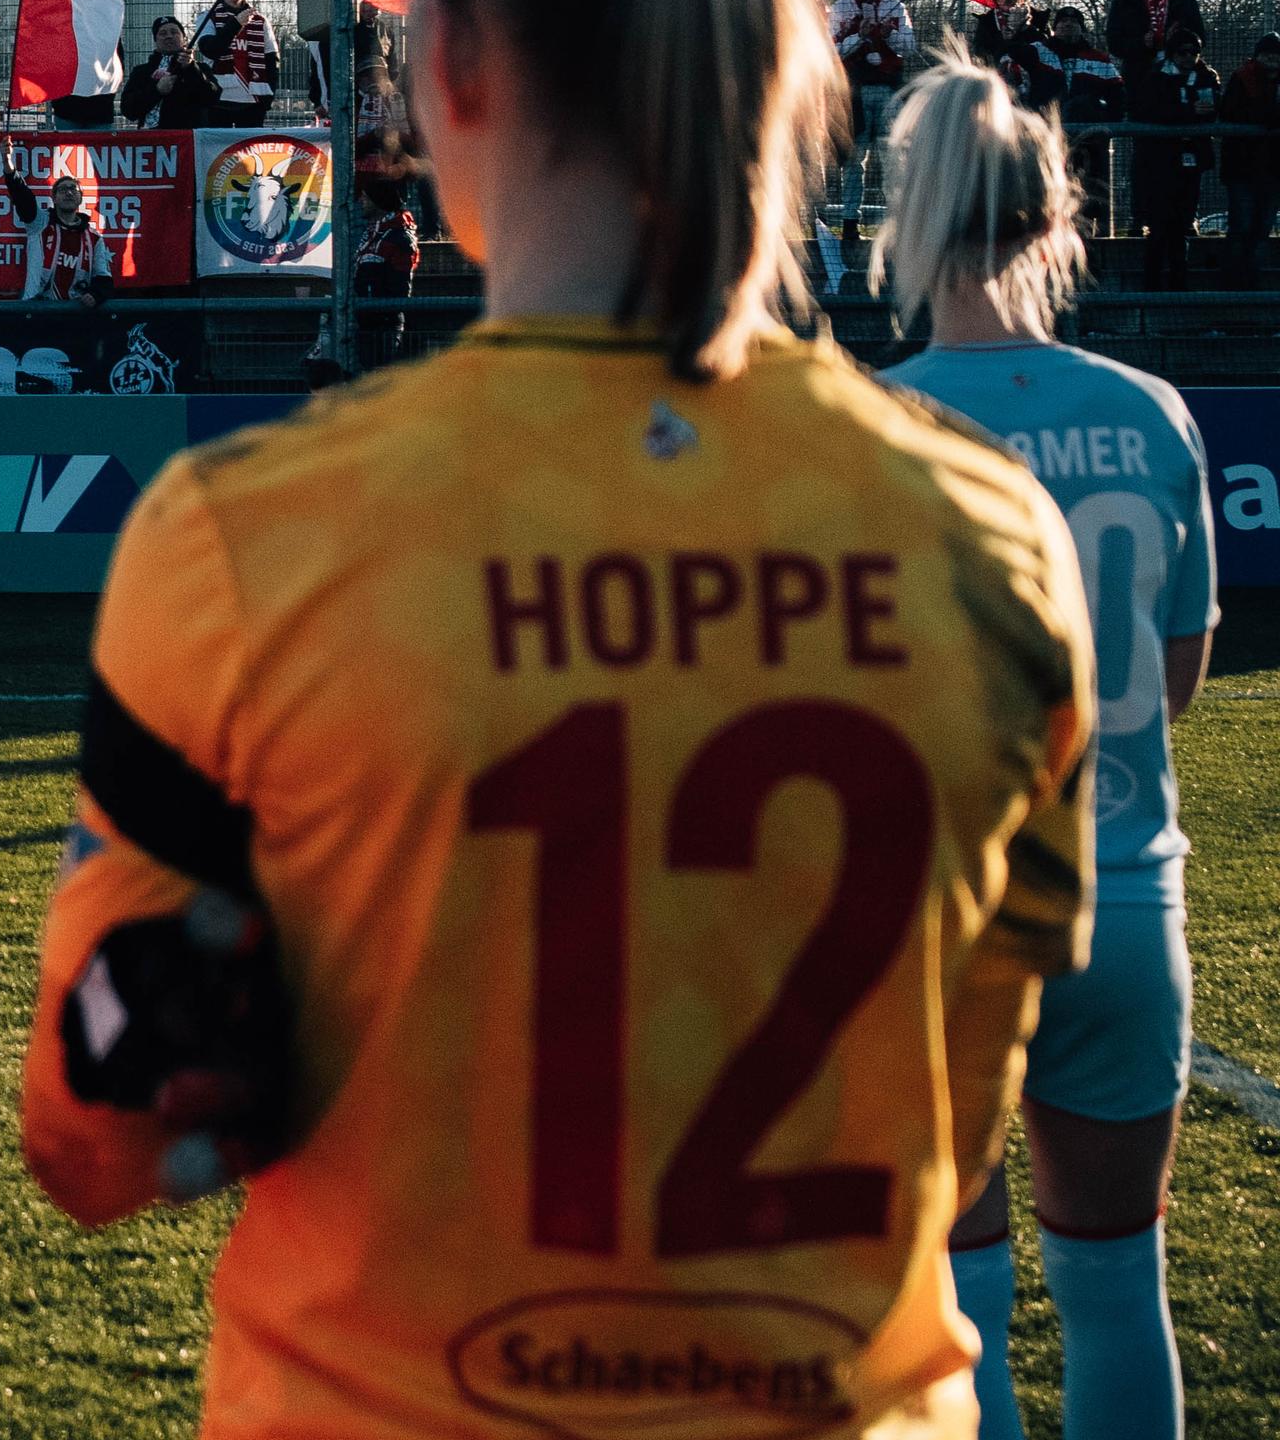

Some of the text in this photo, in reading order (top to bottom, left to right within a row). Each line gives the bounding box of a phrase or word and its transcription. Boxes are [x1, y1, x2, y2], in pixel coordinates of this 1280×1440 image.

[242, 241, 266, 255] SEIT
[486, 551, 909, 674] HOPPE
[466, 696, 937, 1261] 12
[500, 1331, 839, 1407] Schaebens
